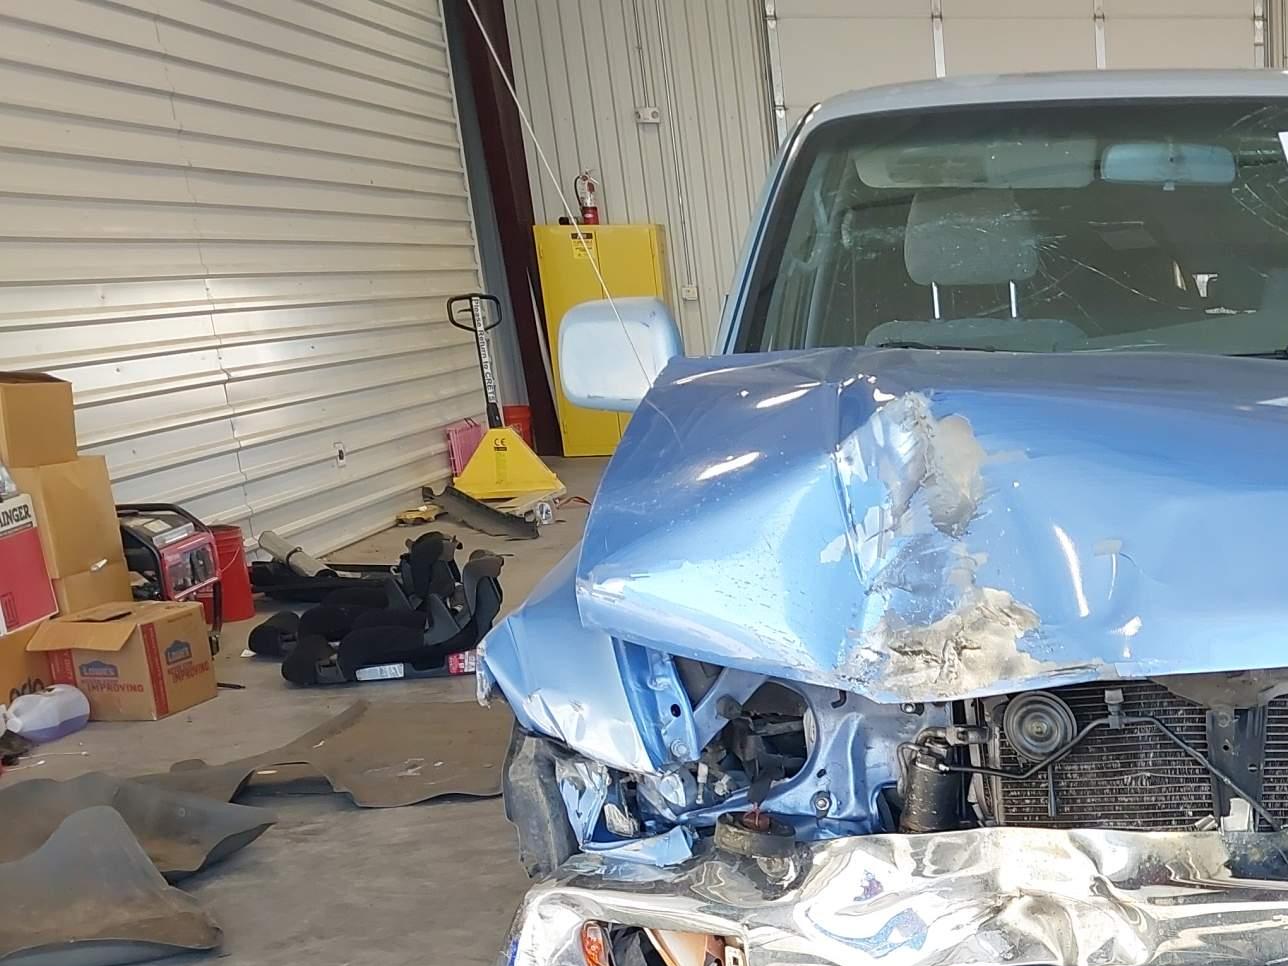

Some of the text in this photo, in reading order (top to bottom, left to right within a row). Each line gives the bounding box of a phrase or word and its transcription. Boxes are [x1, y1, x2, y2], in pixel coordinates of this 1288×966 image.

[473, 298, 482, 329] Please
[478, 330, 488, 358] Return
[482, 361, 491, 370] to
[87, 683, 144, 693] IMPROVING
